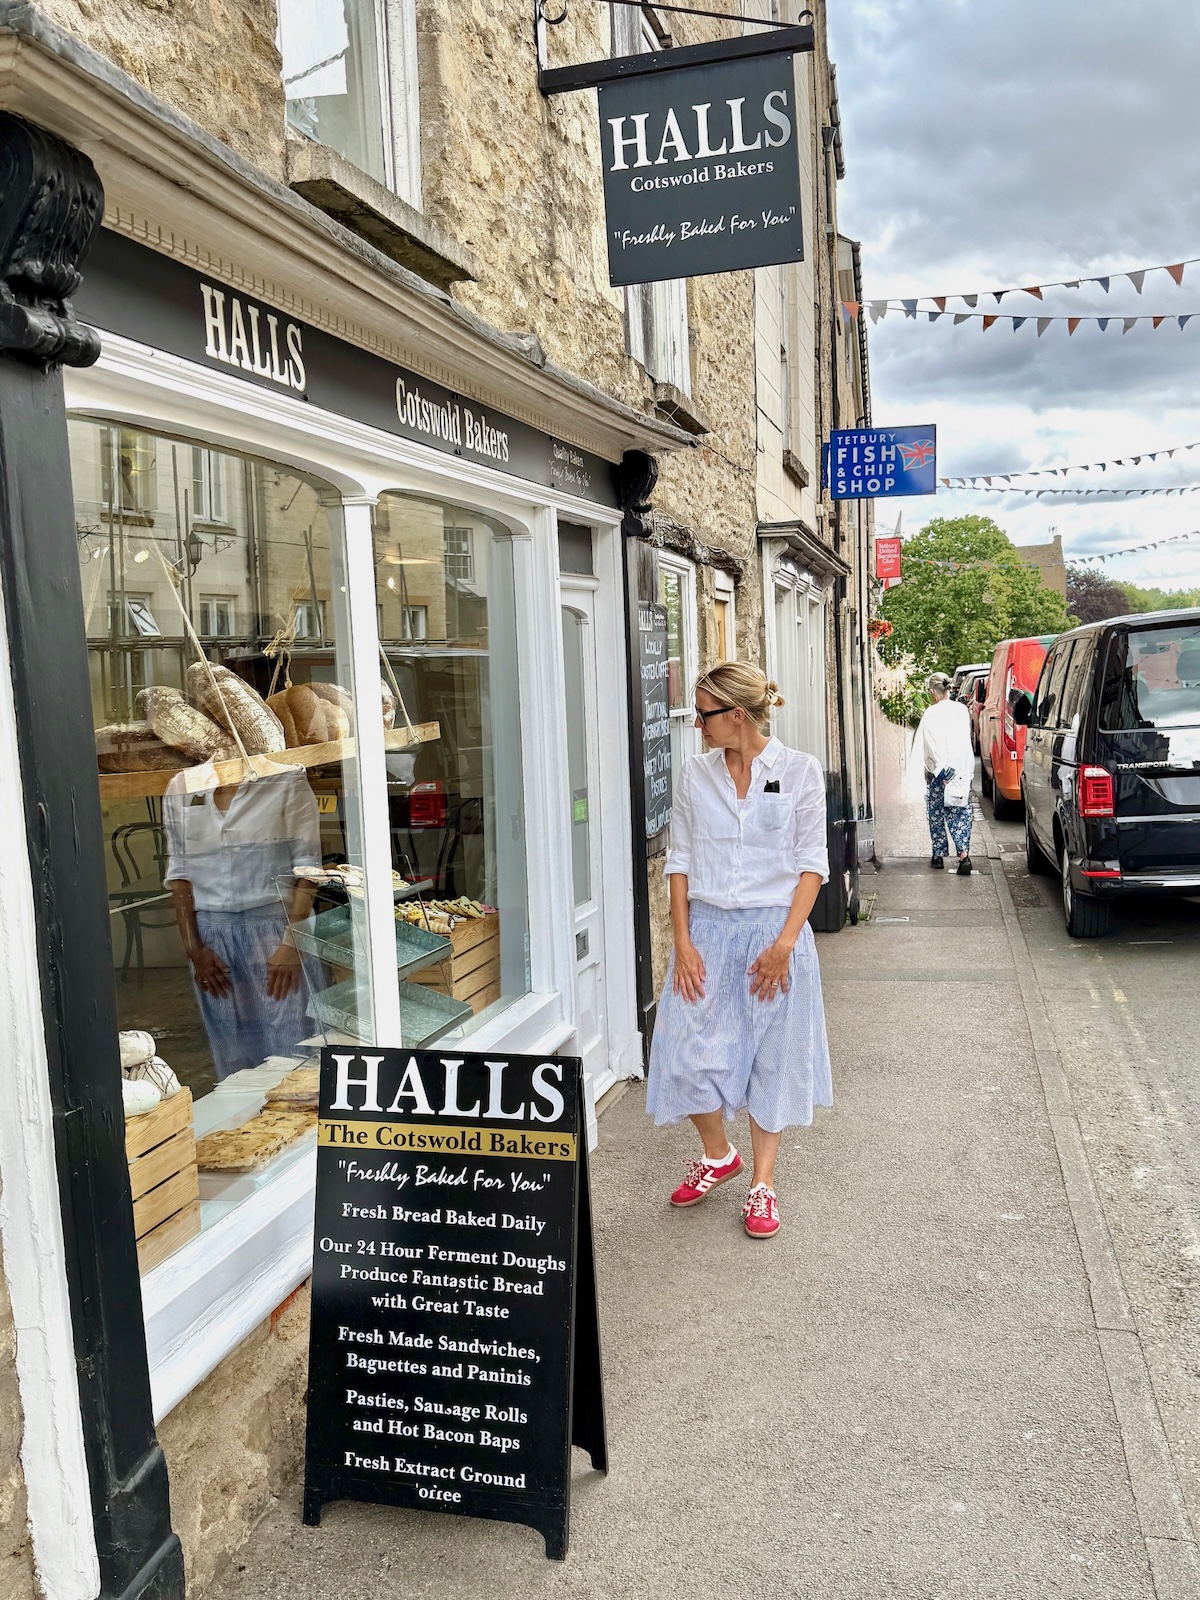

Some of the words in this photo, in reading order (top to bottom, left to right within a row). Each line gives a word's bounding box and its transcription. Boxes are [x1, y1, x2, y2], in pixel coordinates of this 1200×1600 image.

[608, 89, 792, 171] HALLS
[630, 166, 710, 192] Cotswold
[714, 161, 774, 181] Bakers
[614, 224, 677, 249] "Freshly
[680, 216, 726, 240] Baked
[730, 215, 757, 234] For
[761, 206, 796, 228] You"
[200, 282, 307, 392] HALLS
[395, 377, 461, 446] Cotswold
[464, 407, 510, 463] Bakers
[837, 433, 896, 446] TETBURY
[837, 445, 896, 464] FISH
[837, 467, 846, 478] &
[853, 463, 896, 477] CHIP
[837, 478, 896, 494] SHOP
[1116, 761, 1183, 770] TRANSPORT
[330, 1054, 564, 1122] HALLS
[325, 1123, 368, 1145] The
[375, 1127, 482, 1151] Cotswold
[489, 1133, 570, 1157] Bakers
[339, 1160, 410, 1190] "Freshly
[415, 1165, 468, 1186] Baked
[474, 1170, 505, 1191] For
[511, 1172, 550, 1192] You"
[342, 1203, 387, 1219] Fresh
[392, 1206, 441, 1223] Bread
[446, 1210, 496, 1227] Baked
[502, 1214, 546, 1236] Daily
[320, 1238, 352, 1253] Our
[357, 1240, 375, 1255] 24
[380, 1242, 423, 1258] Hour
[428, 1245, 498, 1265] Ferment
[503, 1252, 565, 1274] Doughs
[340, 1264, 407, 1283] Produce
[412, 1270, 488, 1290] Fantastic
[493, 1277, 543, 1295] Bread
[371, 1293, 406, 1309] with
[412, 1296, 458, 1314] Great
[463, 1301, 509, 1318] Taste
[338, 1326, 383, 1344] Fresh
[388, 1331, 433, 1348] Made
[439, 1336, 540, 1363] Sandwiches,
[347, 1353, 426, 1374] Baguettes
[432, 1364, 462, 1378] and
[467, 1365, 531, 1385] Paninis
[346, 1390, 408, 1413] Pasties,
[485, 1405, 527, 1423] Rolls
[353, 1419, 383, 1432] and
[388, 1420, 419, 1437] Hot
[424, 1424, 474, 1443] Bacon
[480, 1431, 520, 1453] Baps
[345, 1452, 390, 1470] Fresh
[395, 1458, 455, 1479] Extract
[460, 1467, 525, 1488] Ground
[415, 1482, 462, 1503] offee
